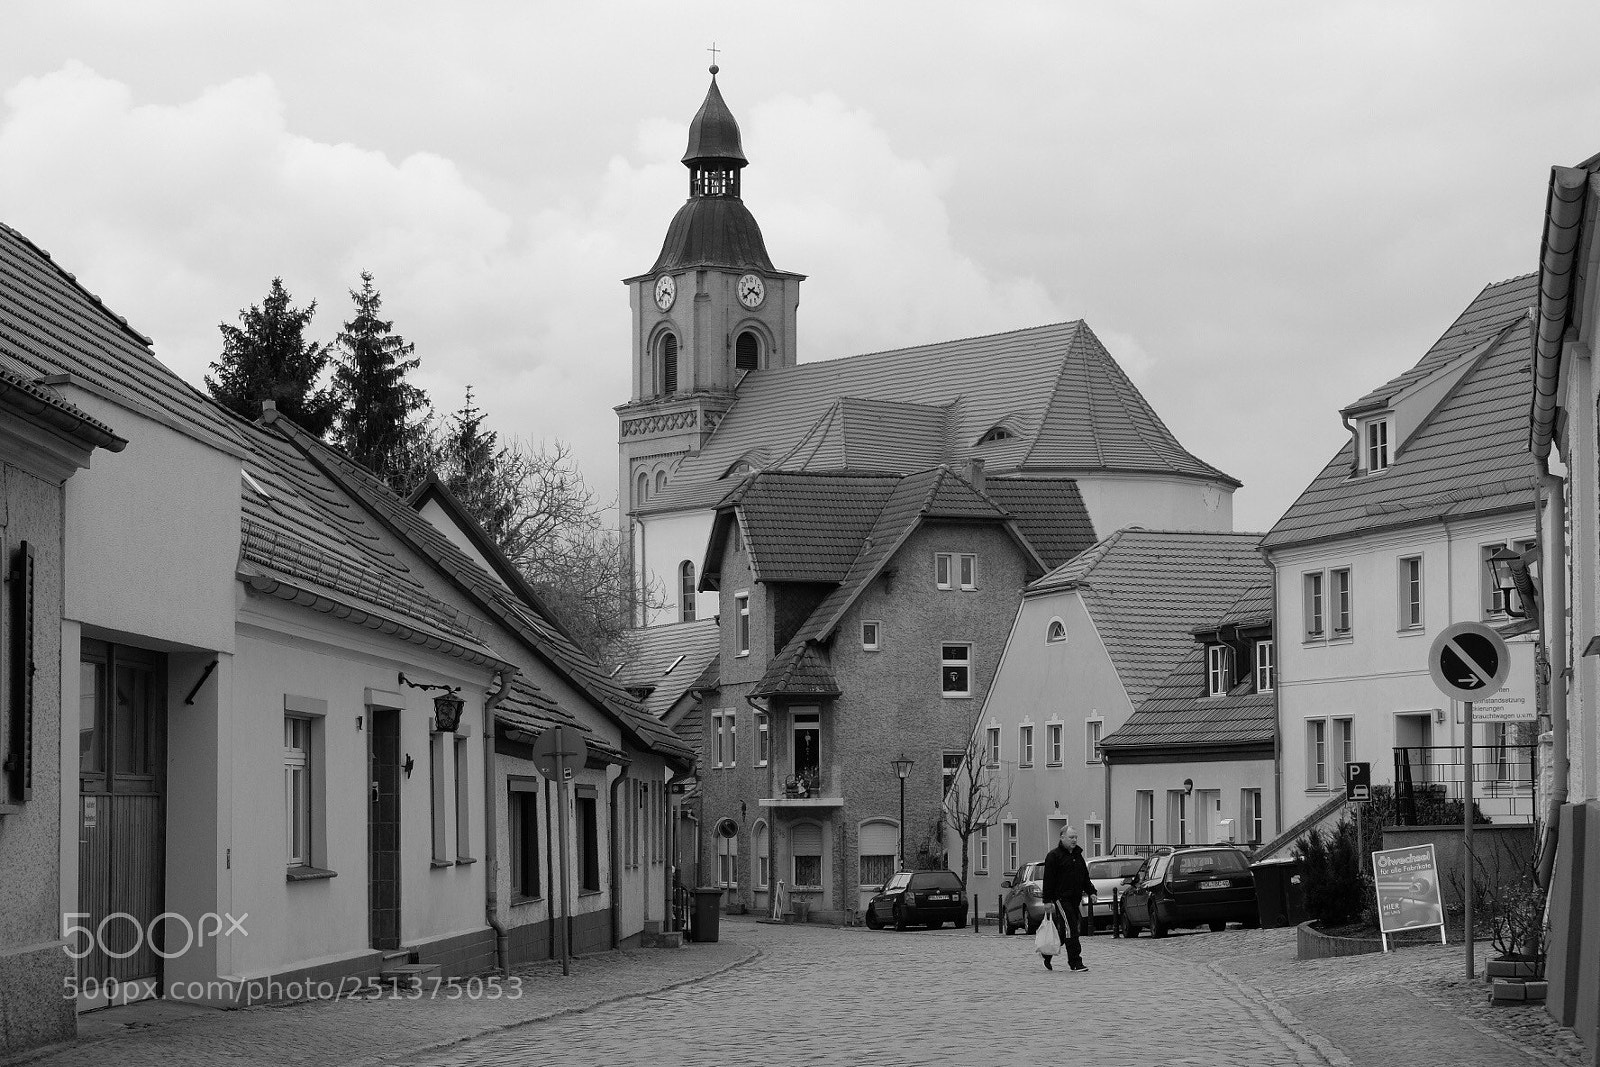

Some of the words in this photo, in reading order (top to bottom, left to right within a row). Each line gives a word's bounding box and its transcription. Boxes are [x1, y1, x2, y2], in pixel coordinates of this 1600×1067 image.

[1472, 704, 1504, 712] kierungen
[1349, 765, 1361, 781] P
[1403, 863, 1431, 872] Fabrikate
